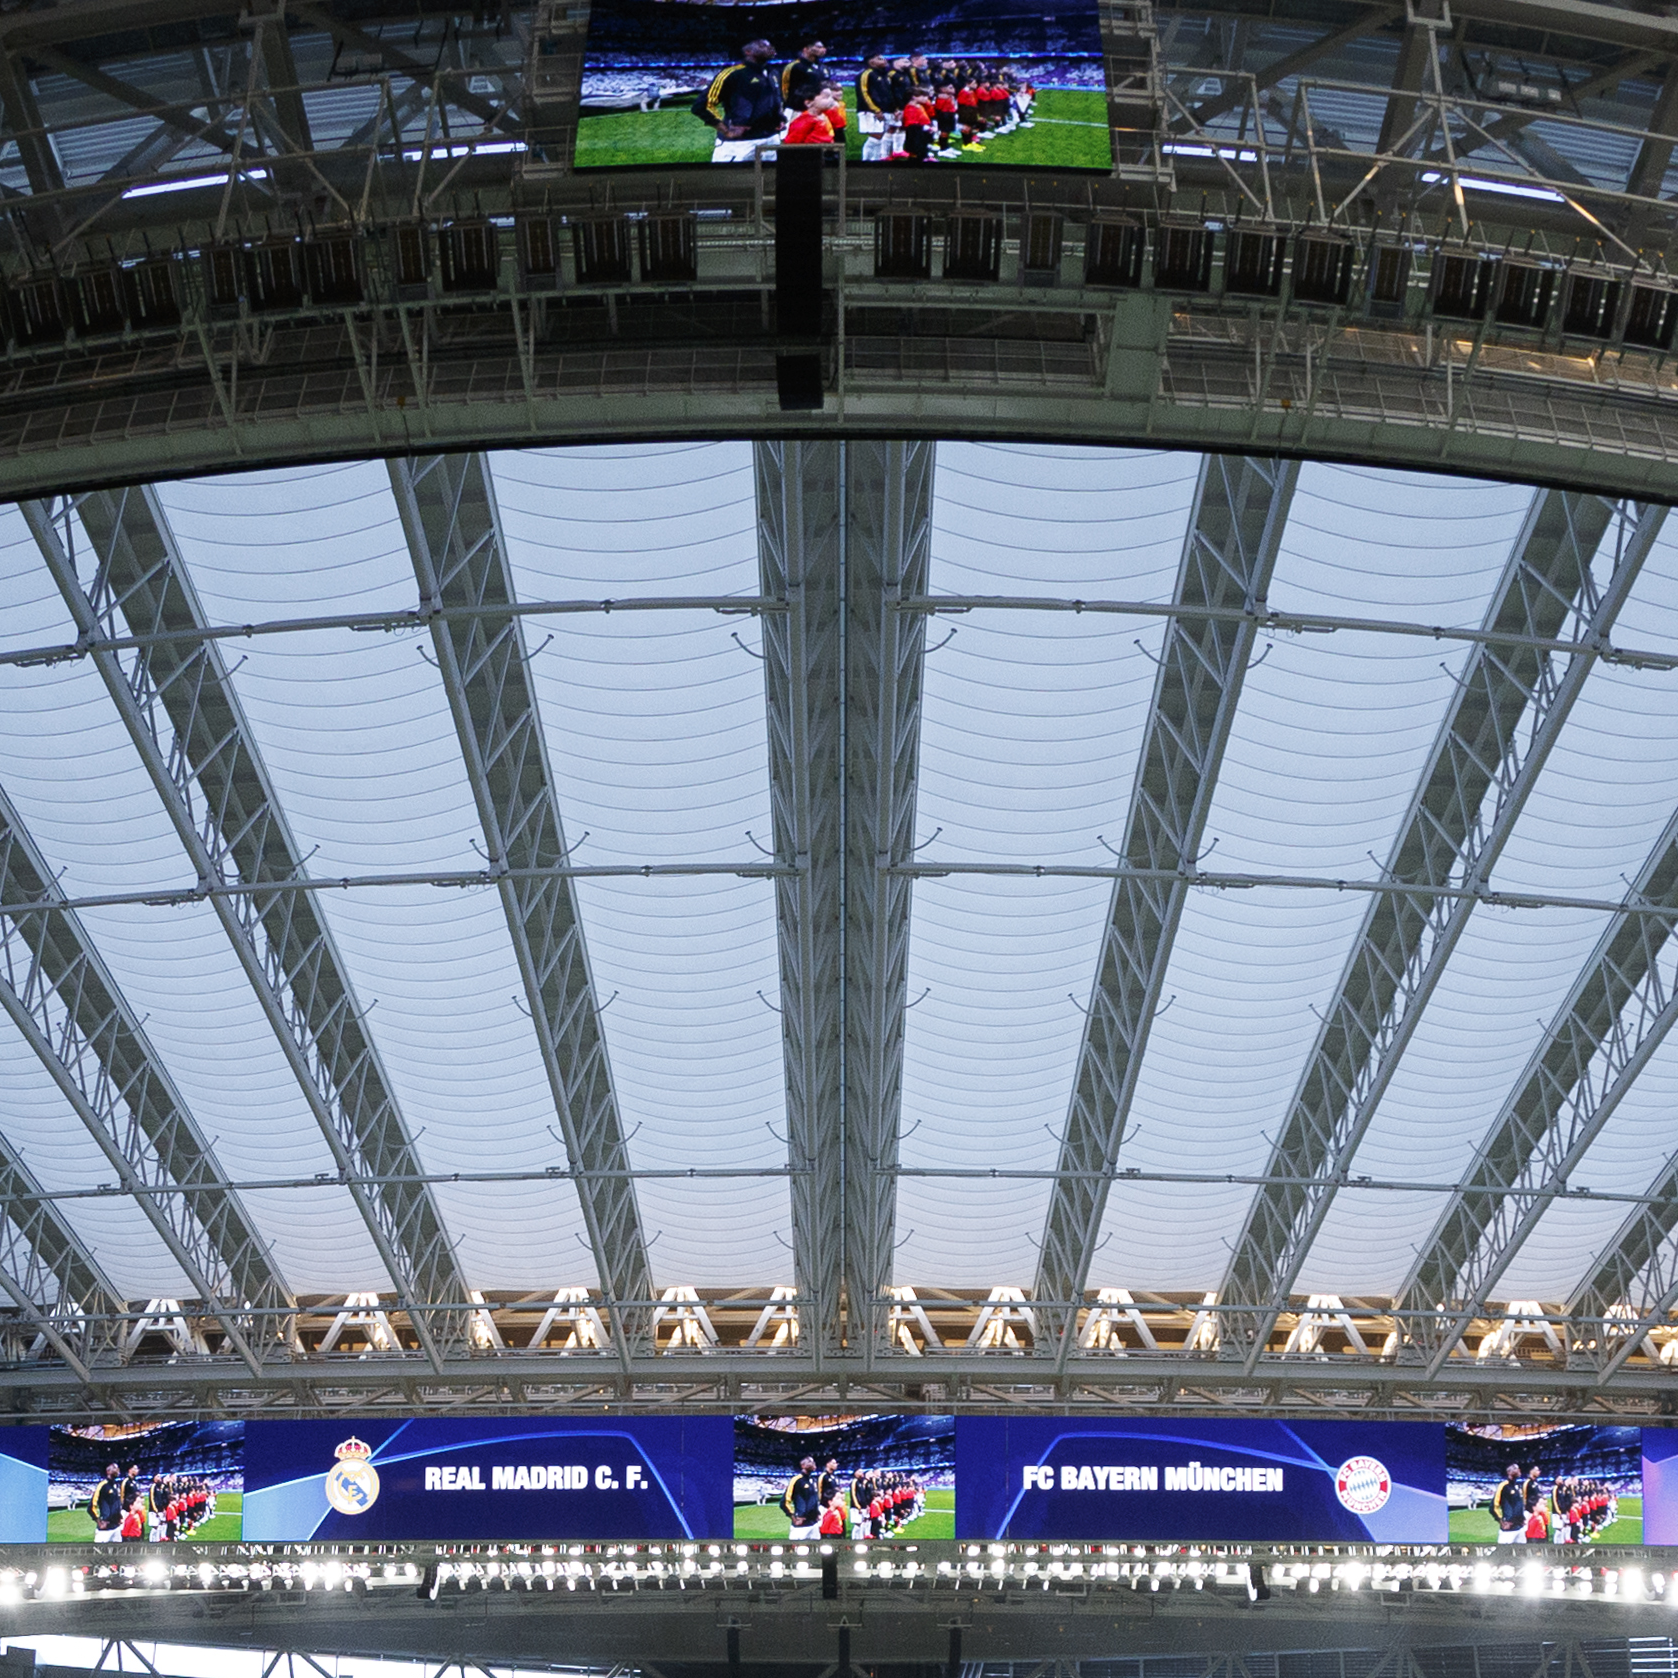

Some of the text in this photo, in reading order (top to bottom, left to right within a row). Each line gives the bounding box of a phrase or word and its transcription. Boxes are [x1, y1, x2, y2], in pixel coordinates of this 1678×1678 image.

[425, 1465, 648, 1490] REAL MADRID C. F.
[1023, 1461, 1284, 1492] FC BAYERN MÜNCHEN
